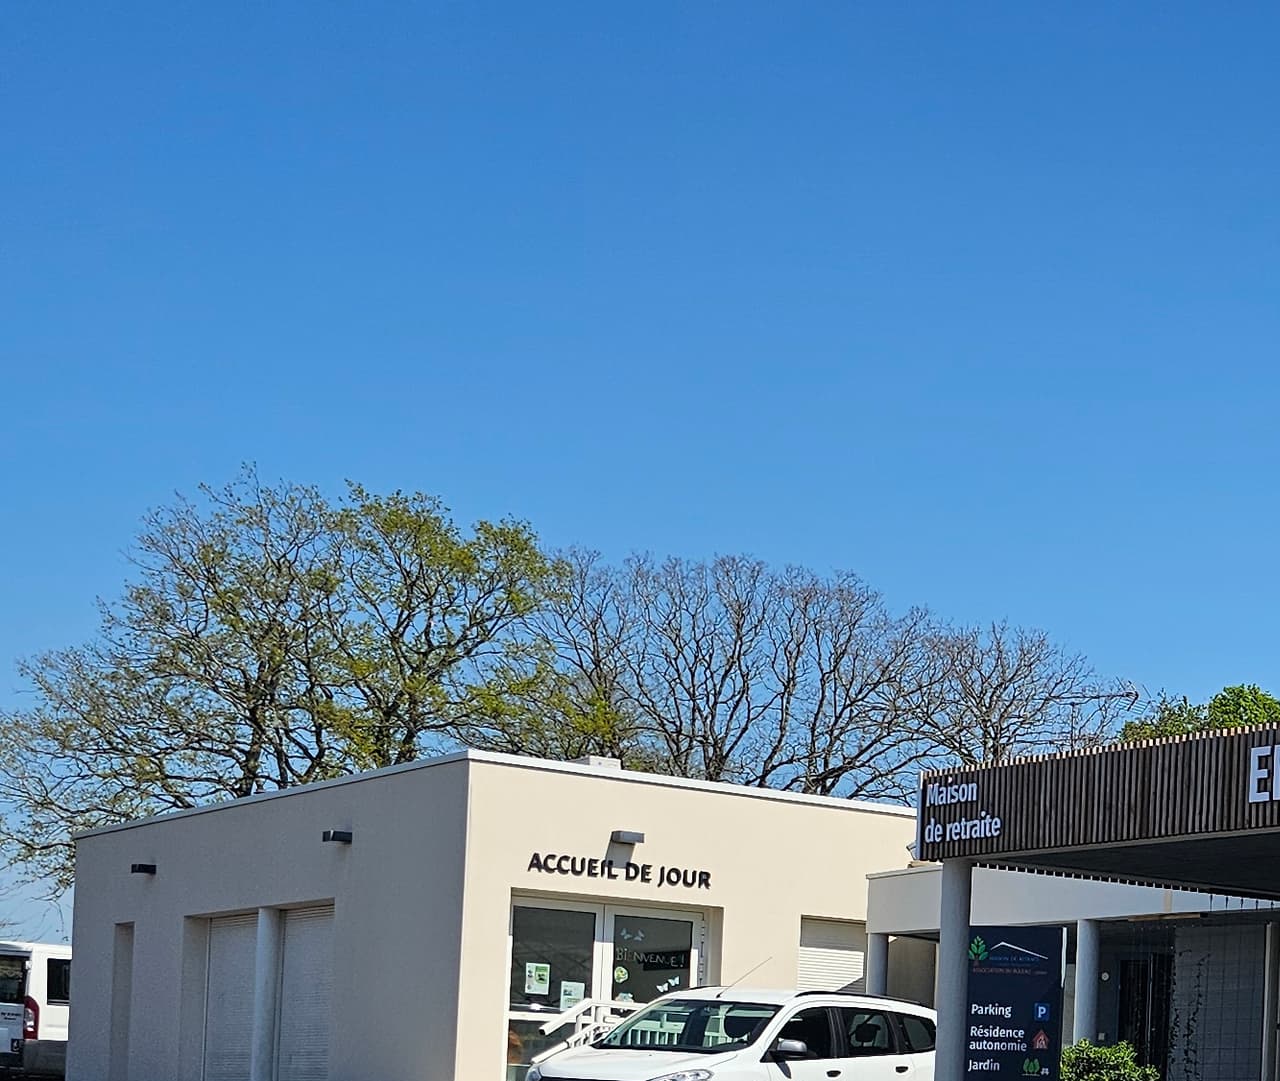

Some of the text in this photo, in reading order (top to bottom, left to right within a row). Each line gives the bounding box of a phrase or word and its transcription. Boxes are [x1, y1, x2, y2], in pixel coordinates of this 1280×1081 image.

[926, 776, 978, 807] Maison
[925, 810, 1001, 843] de retraite
[528, 852, 712, 890] ACCUEIL DE JOUR
[971, 1003, 1012, 1018] Parking
[970, 1025, 1025, 1038] Résidence
[969, 1040, 1027, 1051] autonomie
[968, 1059, 1000, 1072] Jardin
